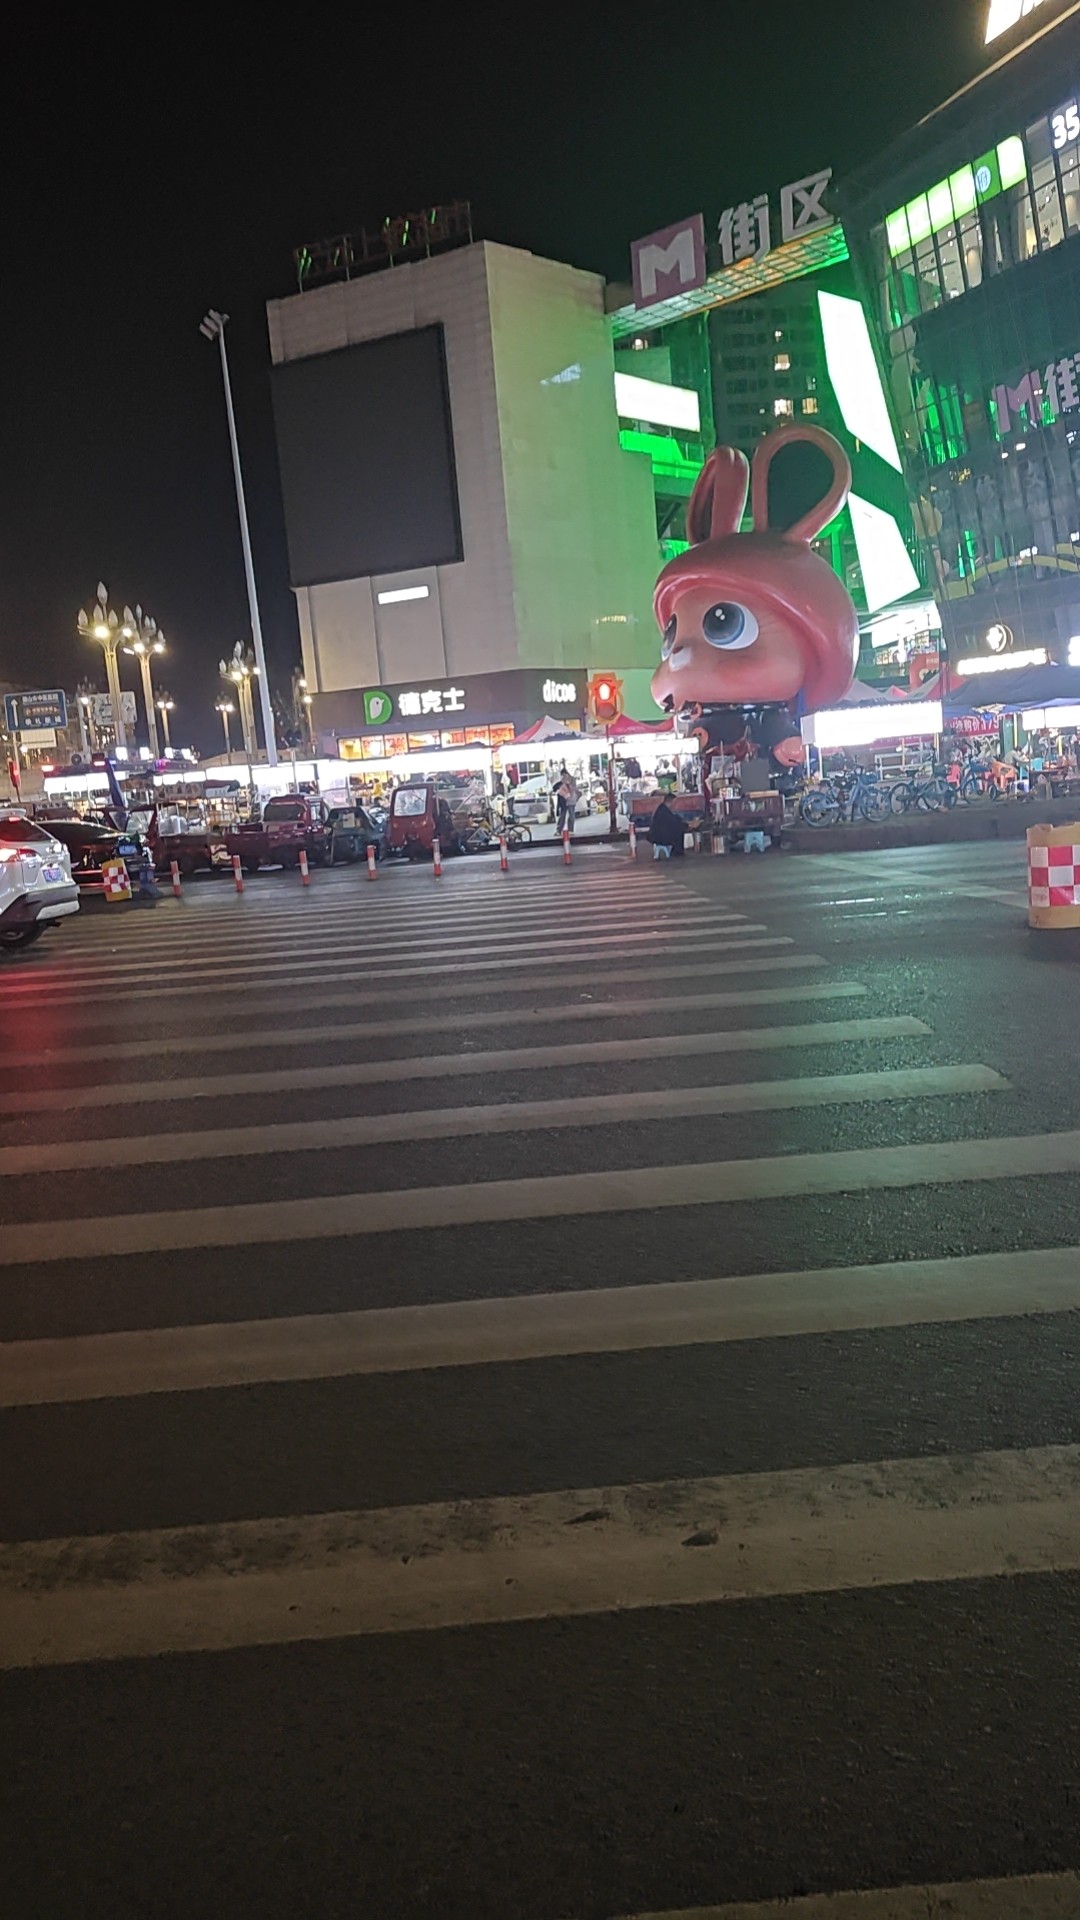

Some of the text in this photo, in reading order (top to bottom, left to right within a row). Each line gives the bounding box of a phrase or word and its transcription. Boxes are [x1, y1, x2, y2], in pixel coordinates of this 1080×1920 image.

[1051, 104, 1080, 150] 35
[398, 687, 465, 716] 德克士
[543, 679, 577, 703] dicos
